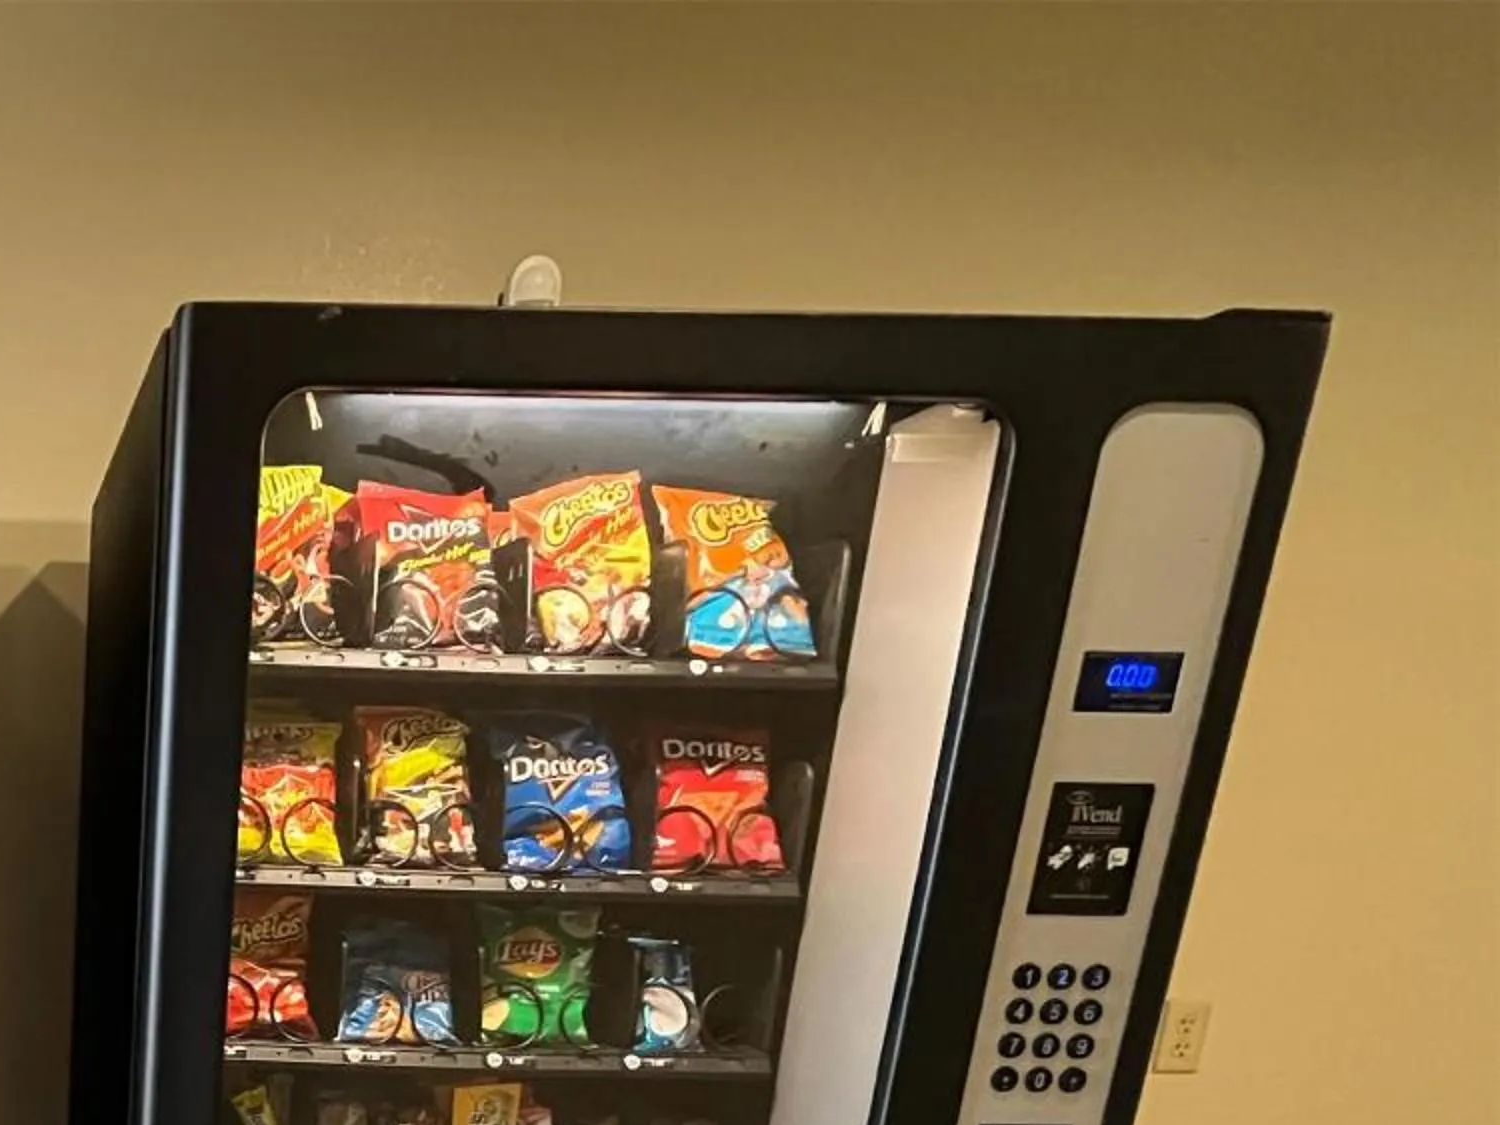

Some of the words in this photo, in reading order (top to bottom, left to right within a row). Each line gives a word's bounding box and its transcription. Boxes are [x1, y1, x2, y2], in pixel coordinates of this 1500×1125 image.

[387, 516, 482, 543] Doritos
[662, 738, 766, 762] Doritos
[509, 753, 609, 783] Doritos
[1024, 970, 1034, 985] 1
[1057, 970, 1070, 985] 2
[1014, 1003, 1026, 1019] 4
[1049, 1003, 1060, 1020] 5
[1083, 1005, 1094, 1021] 6
[1008, 1038, 1018, 1054] 7
[1041, 1038, 1052, 1055] 8
[1076, 1039, 1087, 1055] 9
[1034, 1072, 1045, 1088] 0
